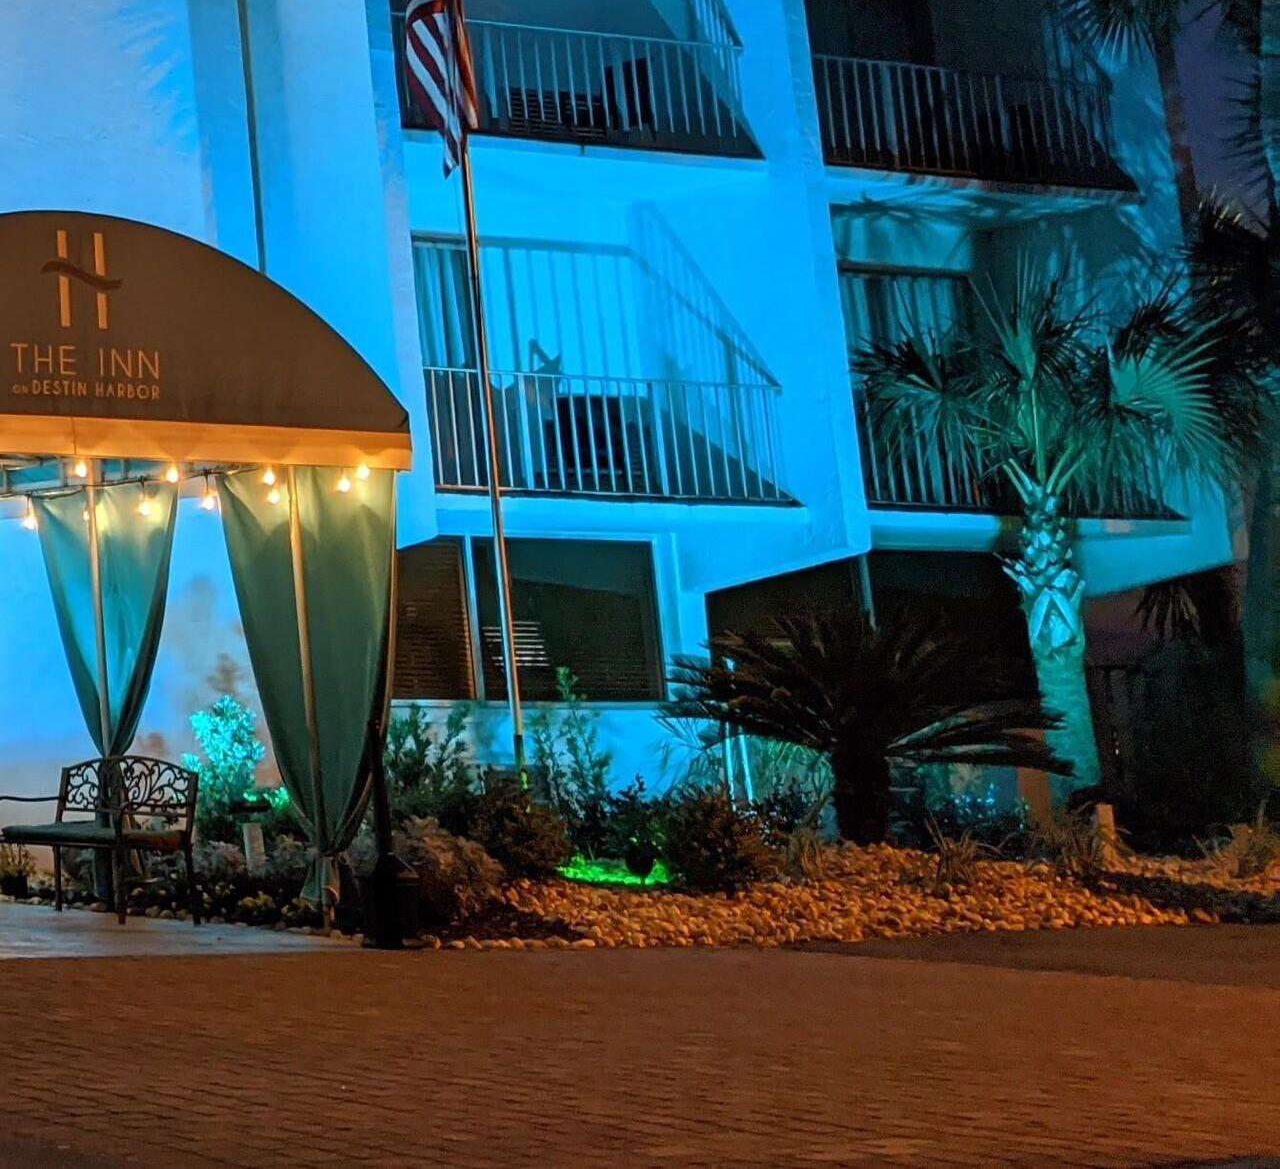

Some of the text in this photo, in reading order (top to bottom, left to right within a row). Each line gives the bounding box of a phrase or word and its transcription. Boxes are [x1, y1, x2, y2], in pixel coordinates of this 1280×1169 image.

[10, 342, 160, 380] THE INN
[32, 380, 88, 397] DESTIN
[95, 382, 161, 401] HARBOR
